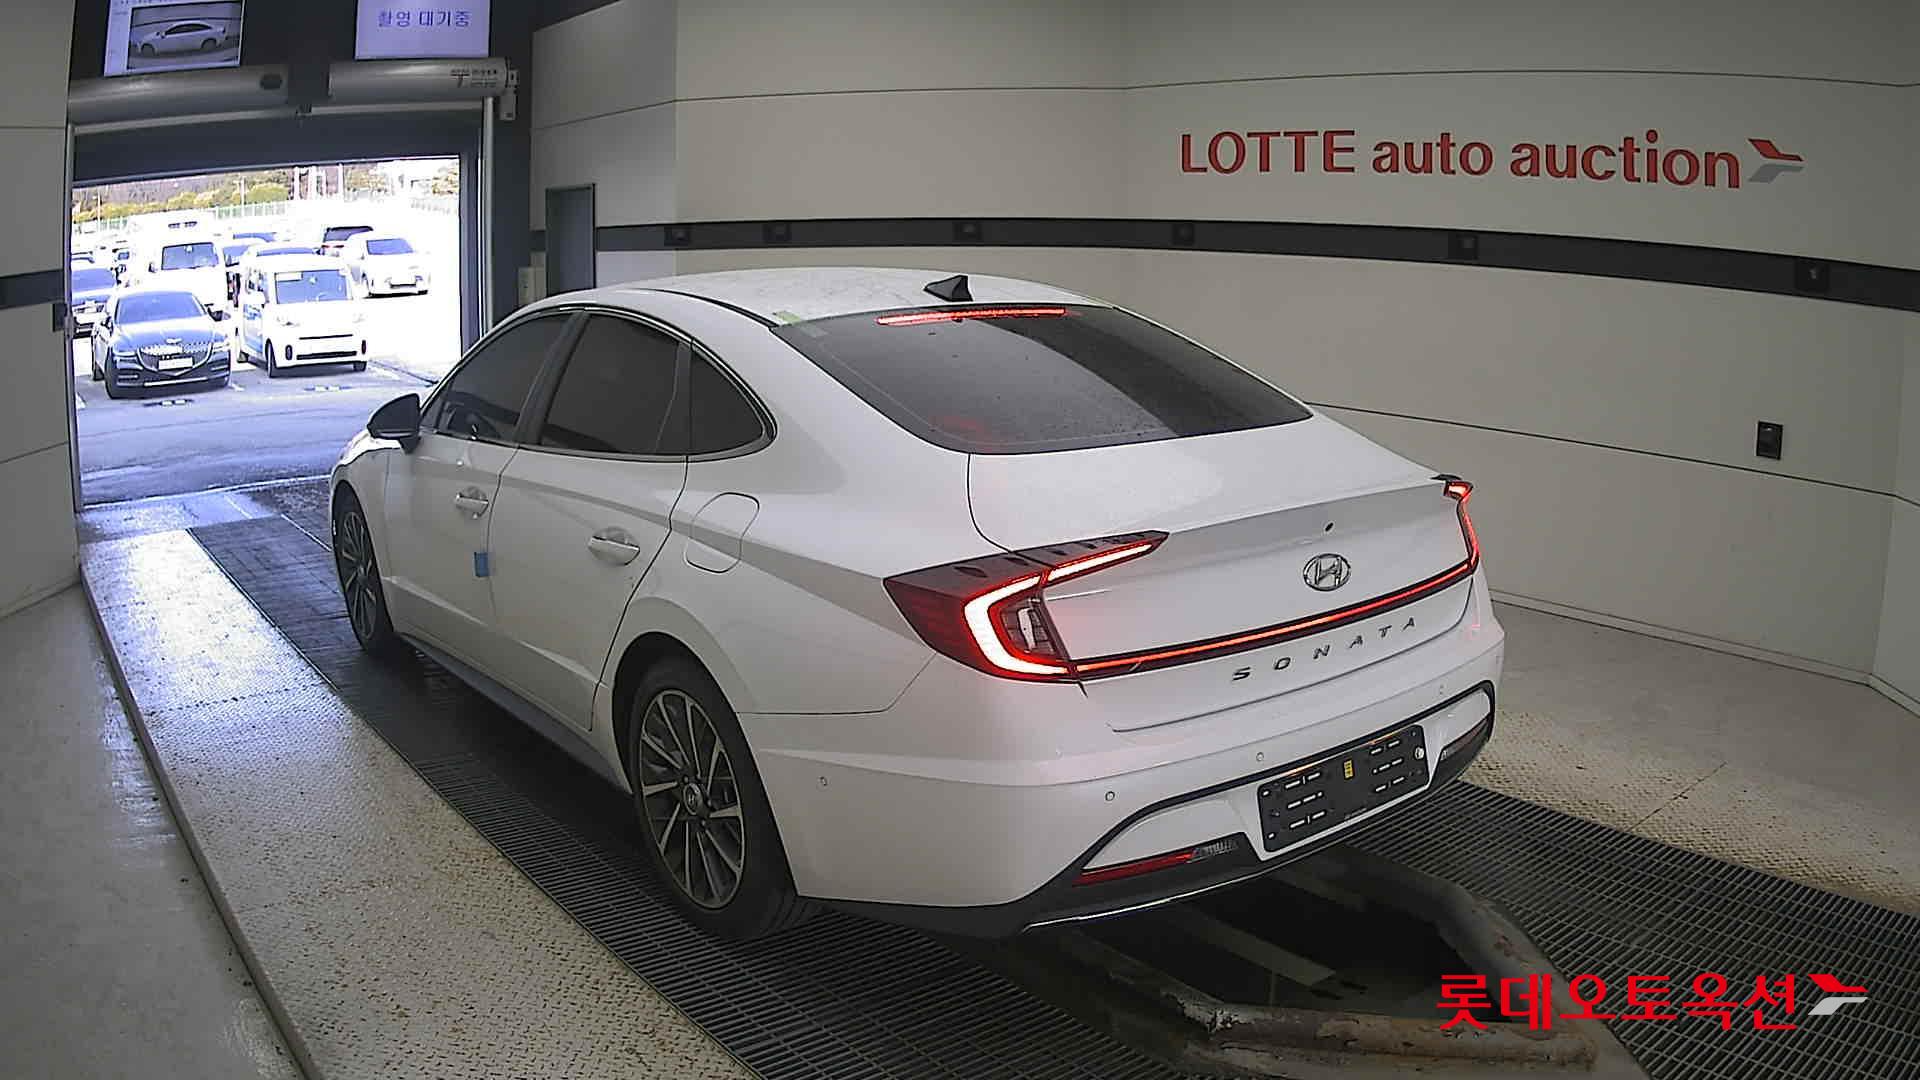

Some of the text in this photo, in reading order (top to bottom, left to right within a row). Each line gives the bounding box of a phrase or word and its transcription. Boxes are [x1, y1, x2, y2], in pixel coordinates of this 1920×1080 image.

[419, 10, 472, 27] 대기중
[1181, 129, 1741, 189] LOTTE auto auction
[1231, 616, 1418, 682] SONATA
